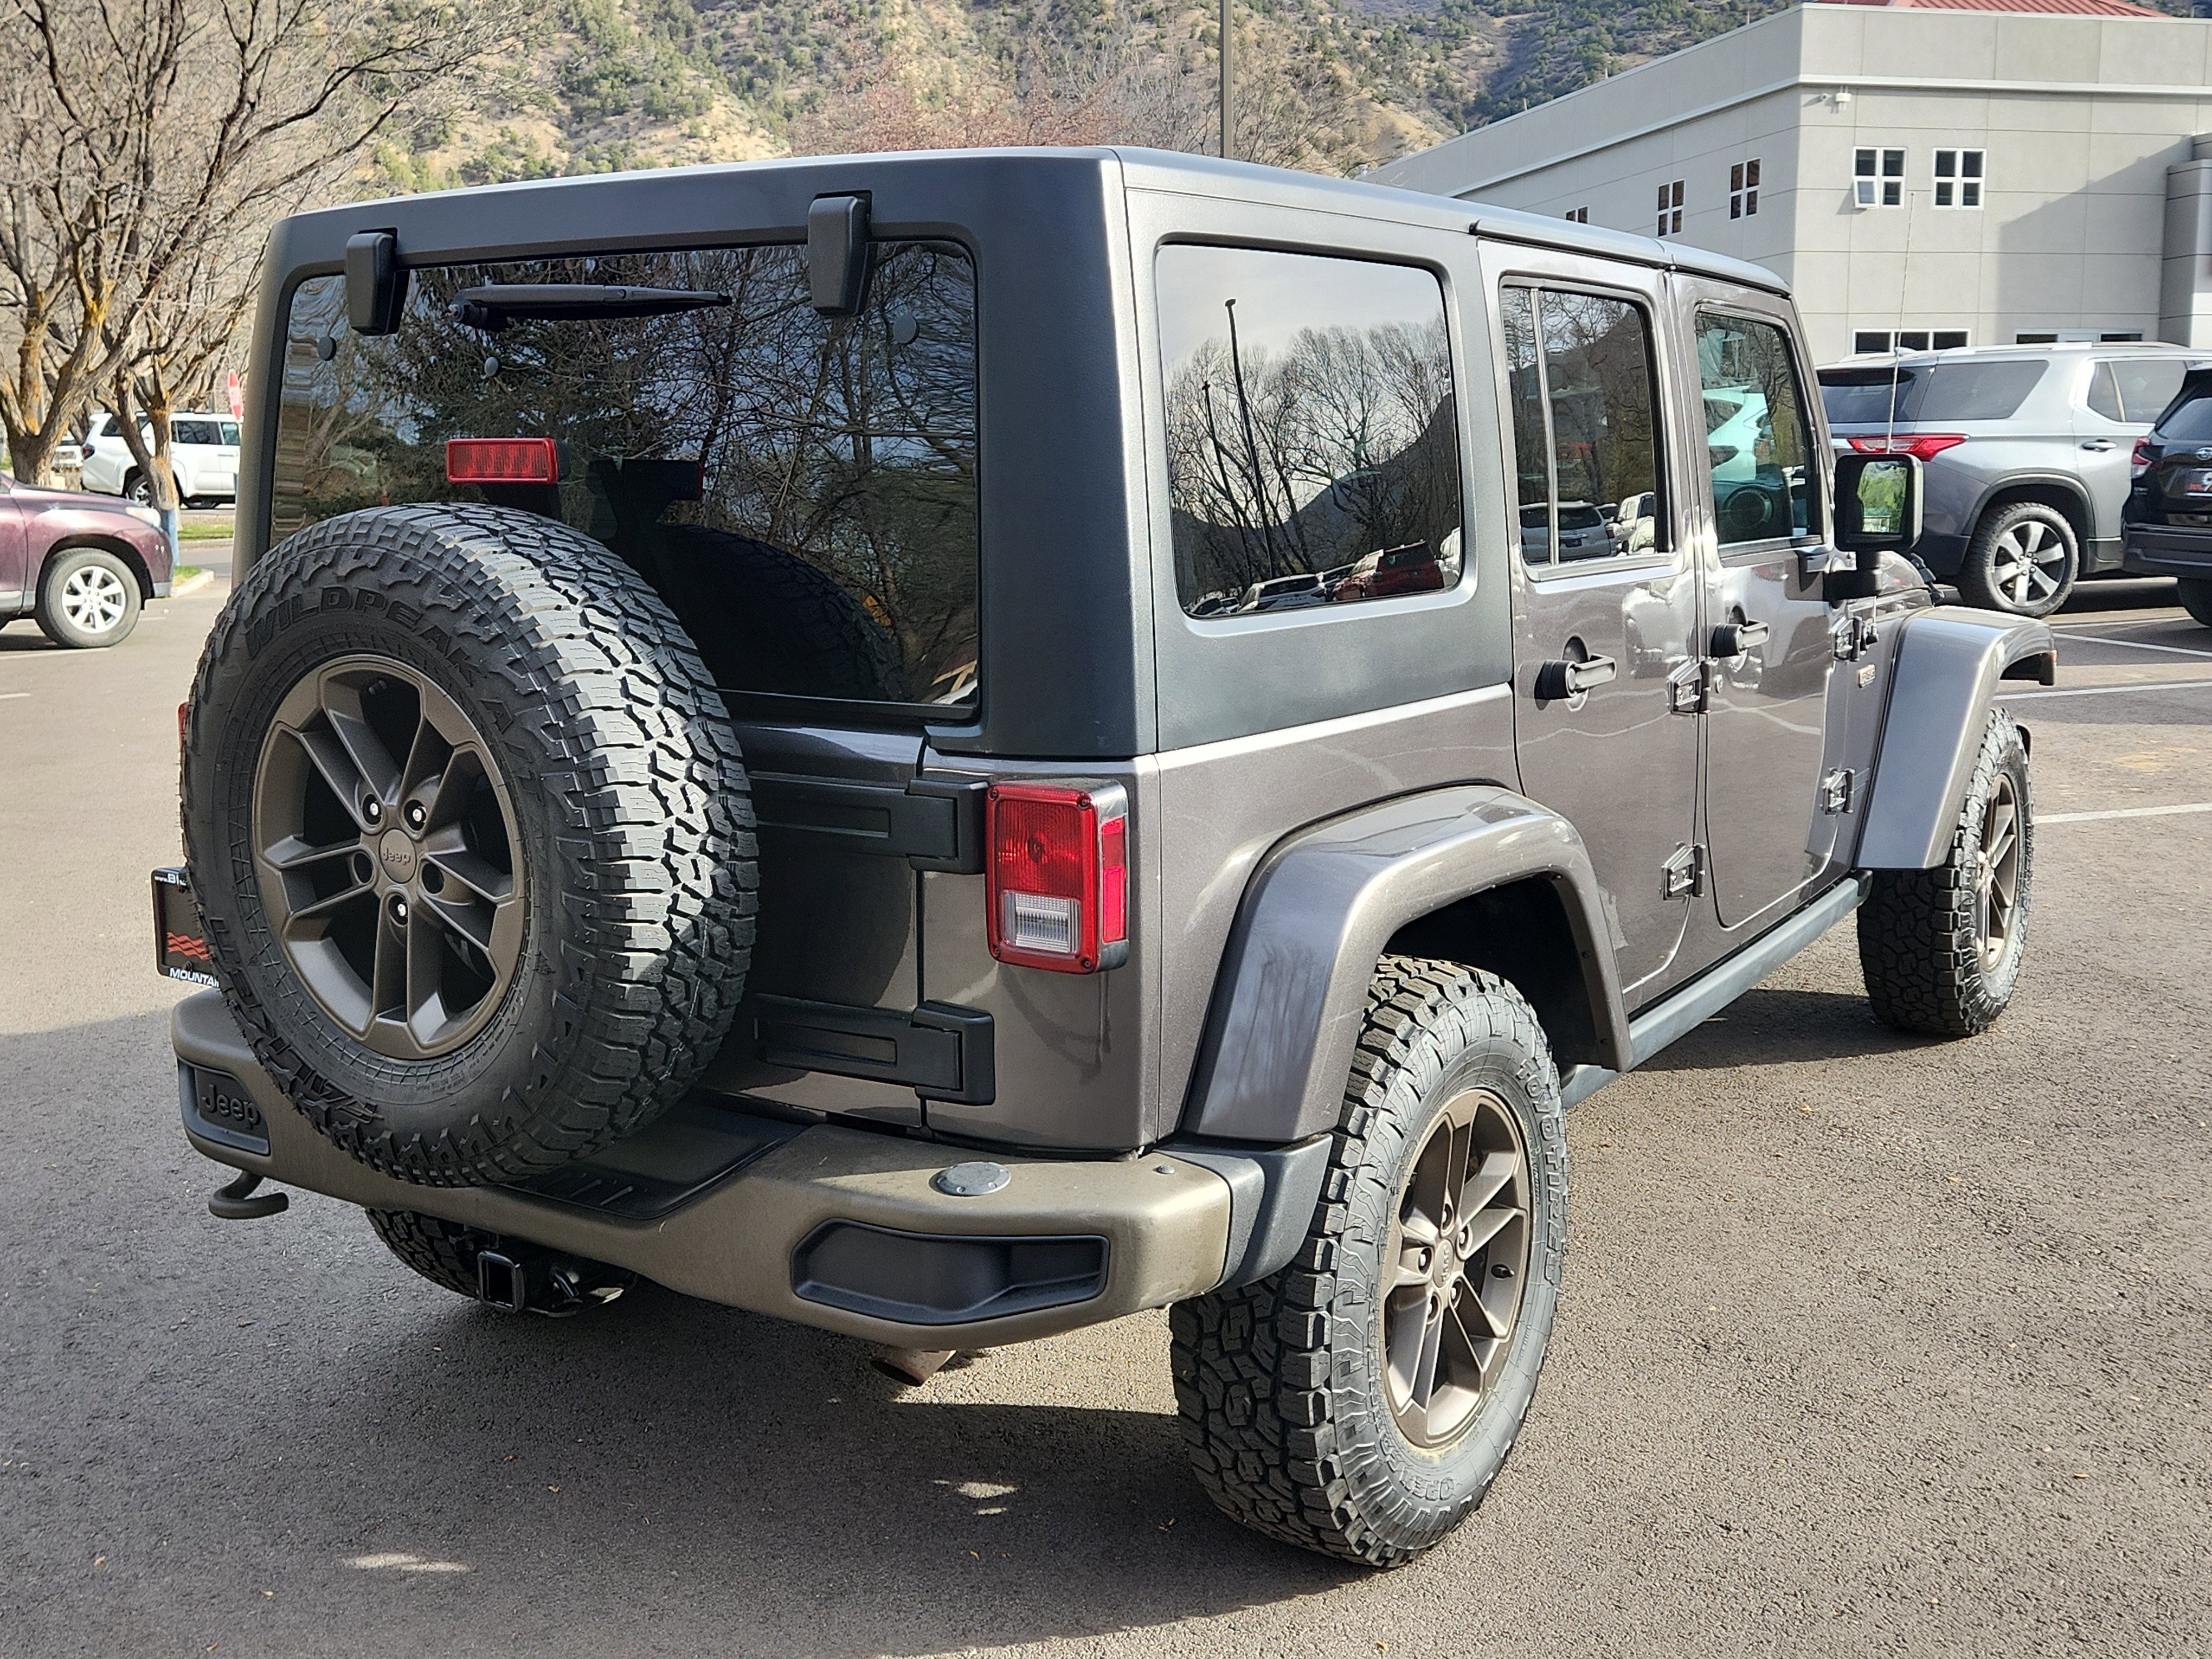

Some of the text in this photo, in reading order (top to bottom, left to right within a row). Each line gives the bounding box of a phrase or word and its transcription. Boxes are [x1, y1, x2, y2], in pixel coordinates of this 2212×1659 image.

[241, 586, 487, 687] WILDPEAK
[383, 847, 411, 866] Jeep
[210, 917, 384, 1123] FALKEN
[201, 1084, 260, 1130] Jeep
[1516, 1058, 1557, 1141] TOYO
[1545, 1143, 1565, 1285] TIRES
